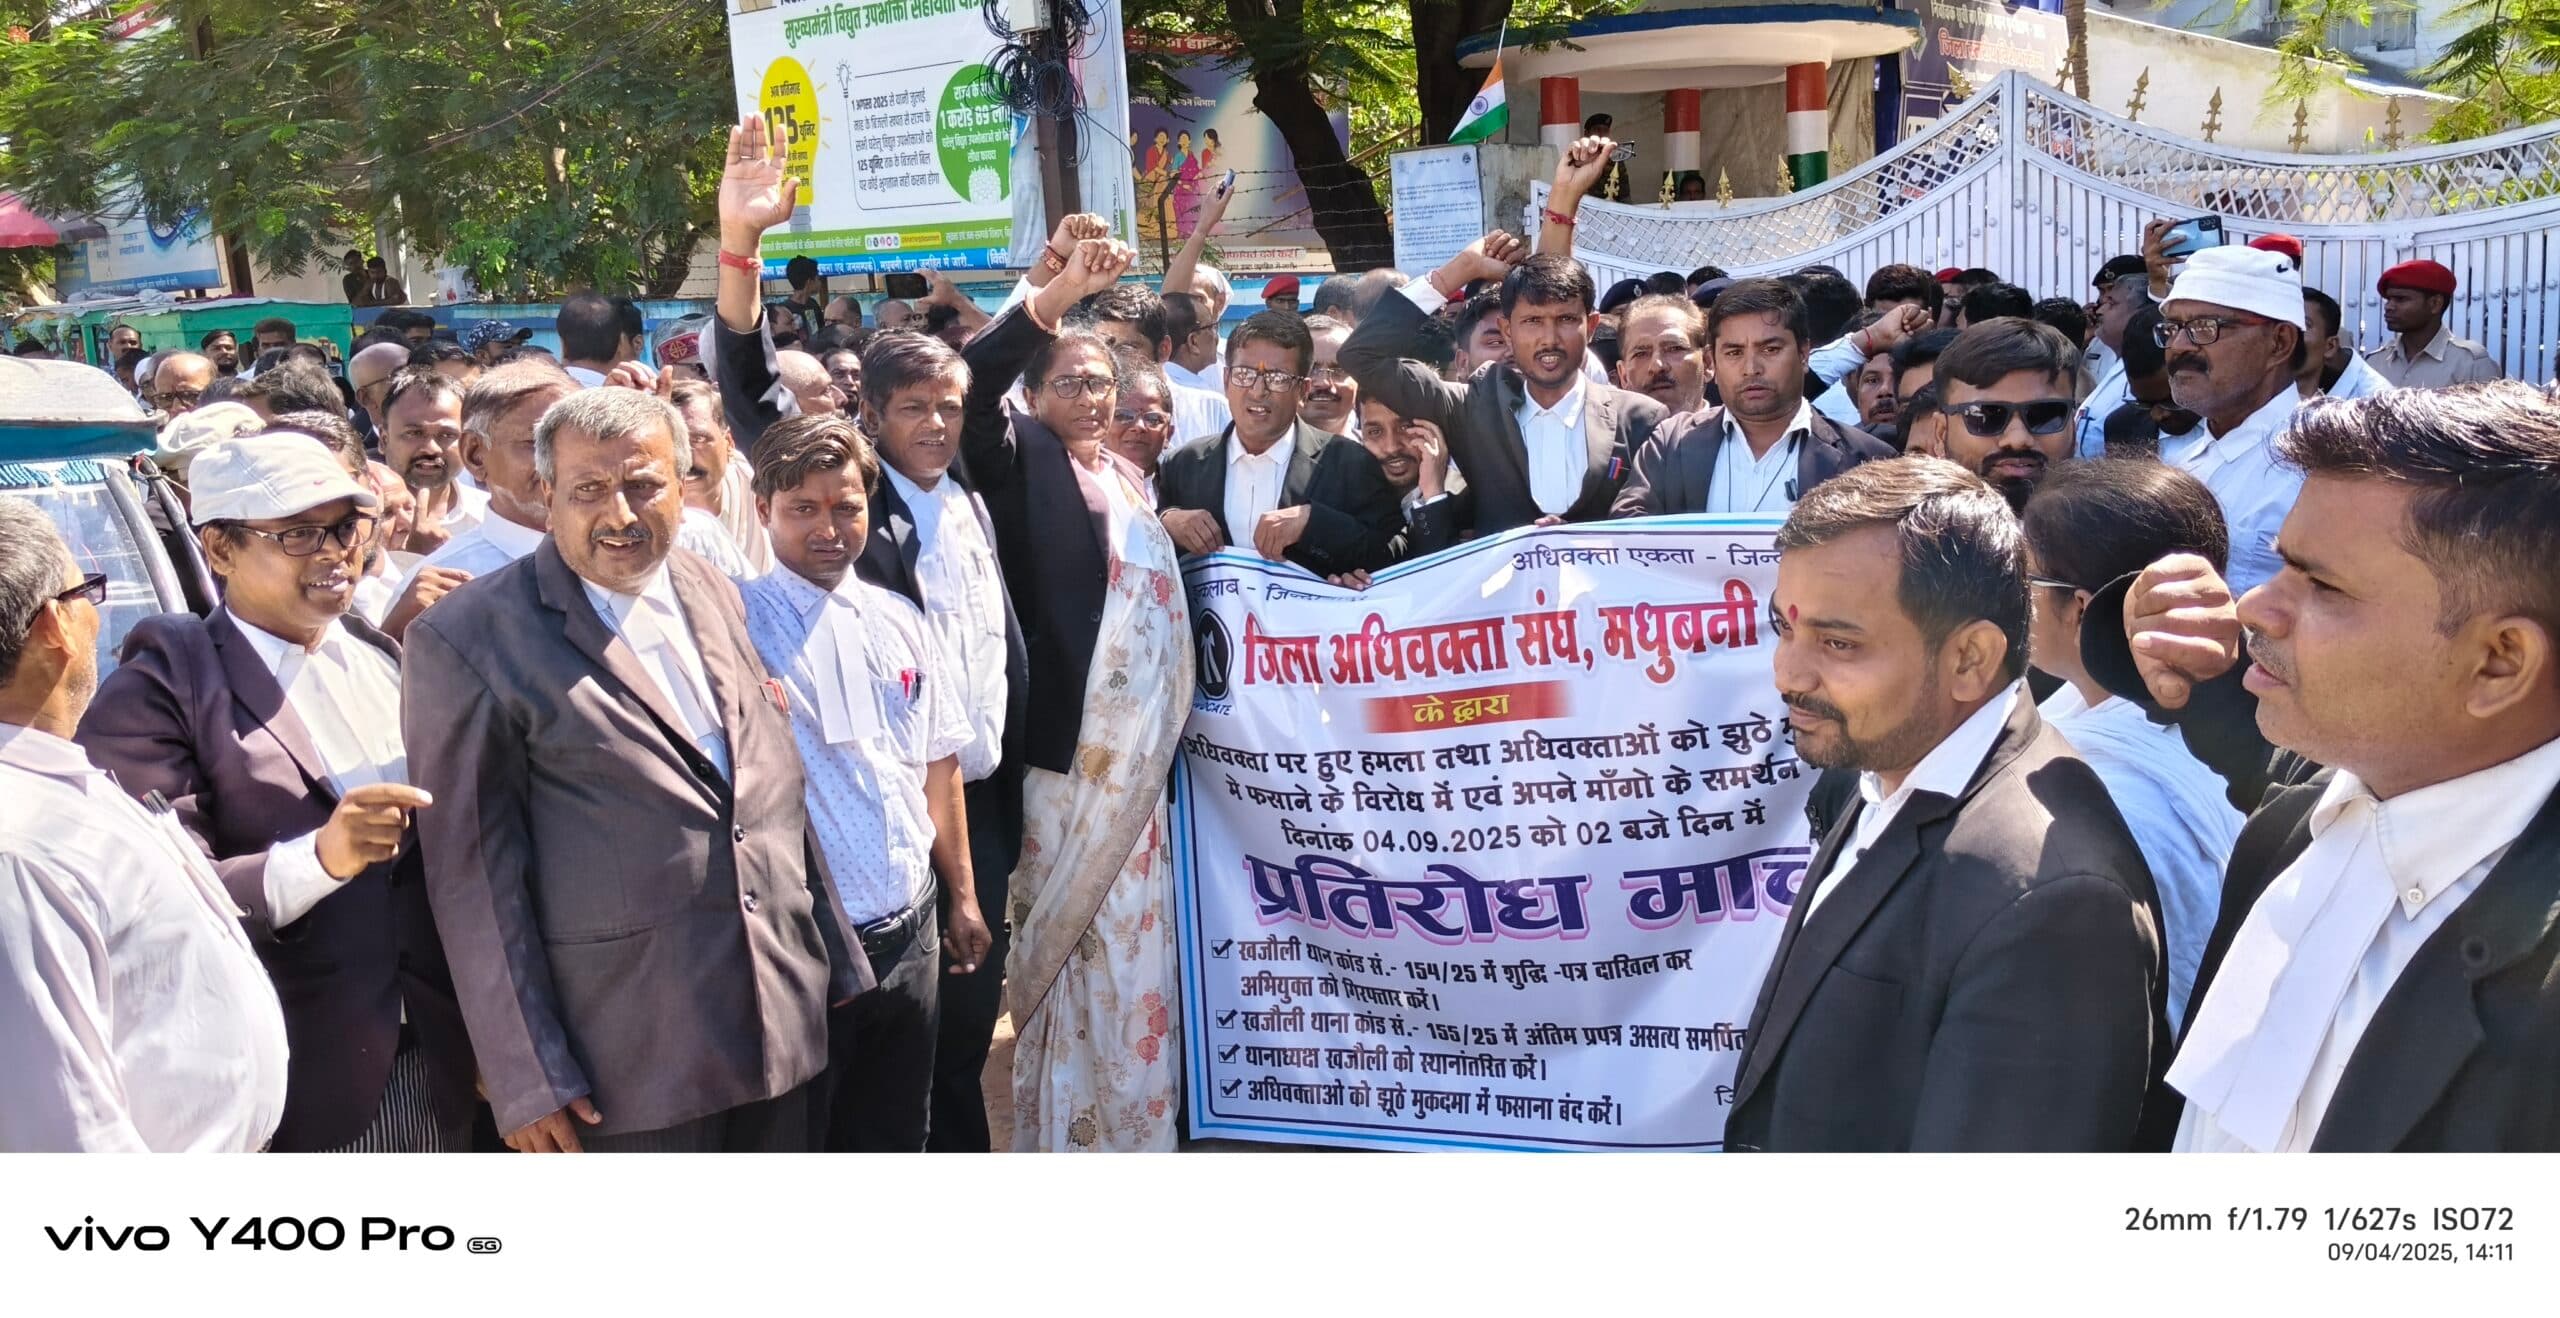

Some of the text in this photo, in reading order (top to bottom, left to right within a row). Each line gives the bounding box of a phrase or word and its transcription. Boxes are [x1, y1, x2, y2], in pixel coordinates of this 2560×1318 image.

[784, 6, 832, 49] मुख्यमंत्री
[833, 3, 862, 39] विद्युत
[1512, 543, 1619, 571] अधिवक्ता
[1626, 547, 1695, 567] एकता
[1243, 578, 1759, 685] जिला अधिवक्ता संघ, मधुबनी
[1412, 693, 1510, 724] के द्वारा
[1183, 733, 1269, 773] अधिवक्ता
[1275, 752, 1307, 773] पर
[1315, 751, 1353, 783] हुए
[1358, 750, 1425, 775] हमला
[1432, 743, 1491, 766] तथा
[1500, 722, 1661, 764] अधिवक्ताओं
[1668, 719, 1710, 751] को
[1245, 783, 1313, 813] फसाने
[1319, 784, 1344, 813] के
[1352, 780, 1425, 812] विरोध
[1432, 780, 1454, 812] में
[1462, 775, 1502, 812] एवं
[1512, 771, 1577, 806] अपने
[1662, 764, 1692, 796] के
[1699, 752, 1801, 793] समर्थन
[1281, 797, 1766, 852] दिनांक 04.09.2025 को 02 बजे दिन में
[1243, 853, 1592, 945] प्रतिरोध
[1238, 937, 1302, 962] खजौली
[1336, 948, 1364, 974] कांड
[1404, 960, 1477, 984] 154/25
[1481, 958, 1498, 983] में
[1501, 958, 1549, 990] शुद्धि
[1592, 954, 1660, 981] दाखिल
[1663, 949, 1694, 971] कर
[1241, 970, 1313, 1004] अभियुक्त
[1318, 973, 1339, 998] को
[1343, 978, 1403, 1008] गिरफ्तार
[1241, 1005, 1305, 1033] खजौली
[1311, 1012, 1349, 1034] थाना
[1354, 1011, 1386, 1035] कांड
[1426, 1022, 1498, 1046] 155/25
[1504, 1022, 1518, 1046] में
[1525, 1022, 1577, 1046] अंतिम
[1582, 1025, 1622, 1047] प्रपत्र
[1629, 1024, 1680, 1050] असत्य
[1245, 1046, 1320, 1069] थानाध्यक्ष
[1325, 1042, 1388, 1071] खजौली
[1393, 1046, 1414, 1073] को
[1419, 1050, 1506, 1079] स्थानांतरित
[1349, 1080, 1371, 1108] को
[1411, 1089, 1471, 1119] मुकदमा
[1476, 1087, 1490, 1116] में
[1496, 1094, 1553, 1121] फसाना
[1558, 1092, 1583, 1124] बंद
